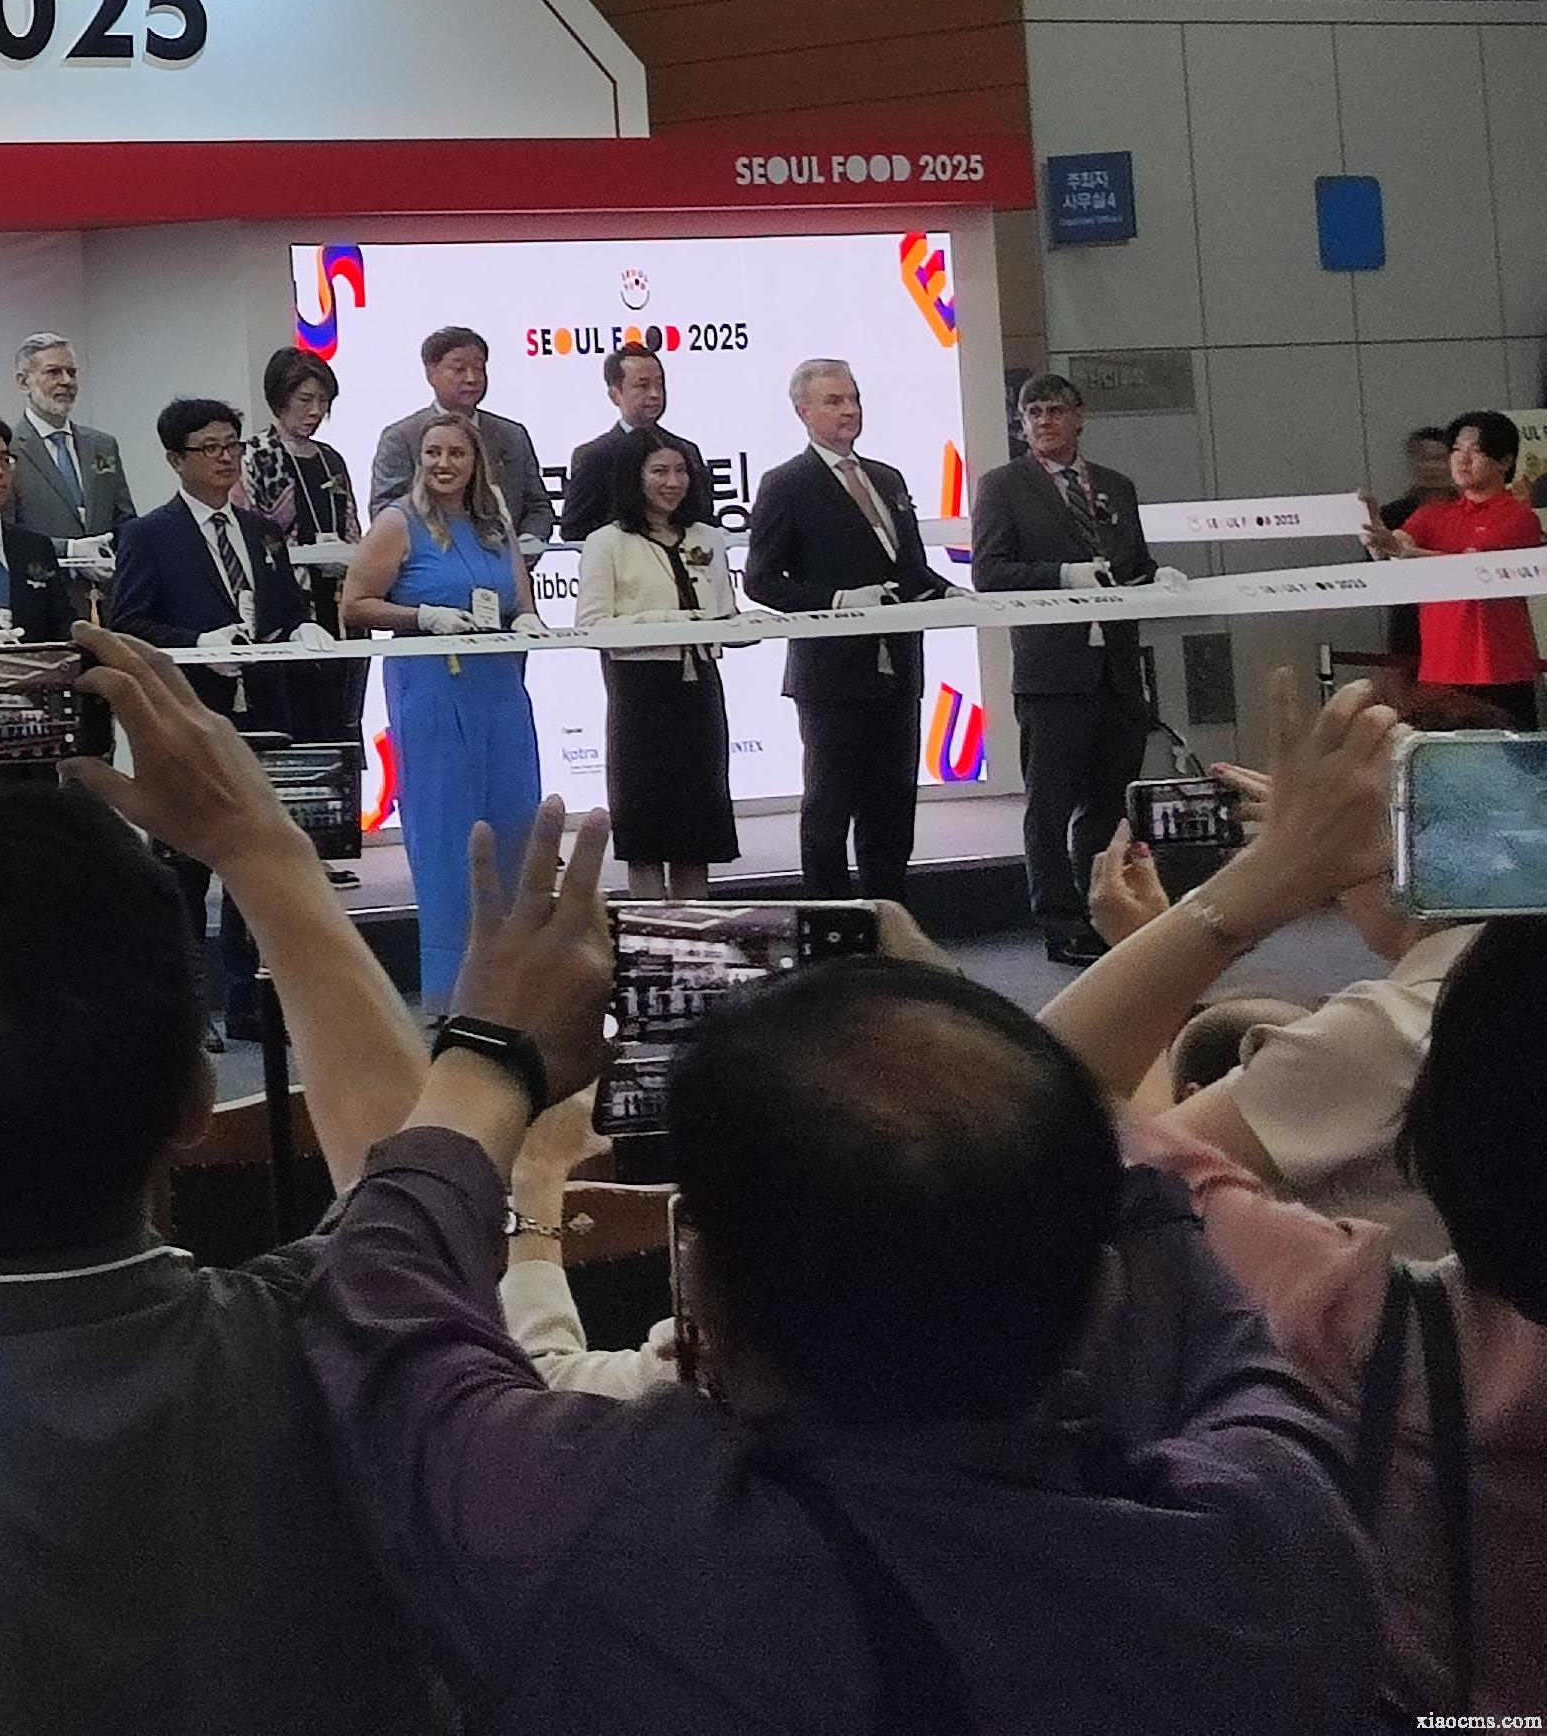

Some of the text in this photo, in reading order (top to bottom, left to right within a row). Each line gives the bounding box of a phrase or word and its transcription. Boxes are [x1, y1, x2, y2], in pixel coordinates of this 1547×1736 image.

[735, 153, 985, 185] SEOUL FOOD 2025
[527, 326, 605, 356] SEOUL
[688, 322, 749, 351] 2025
